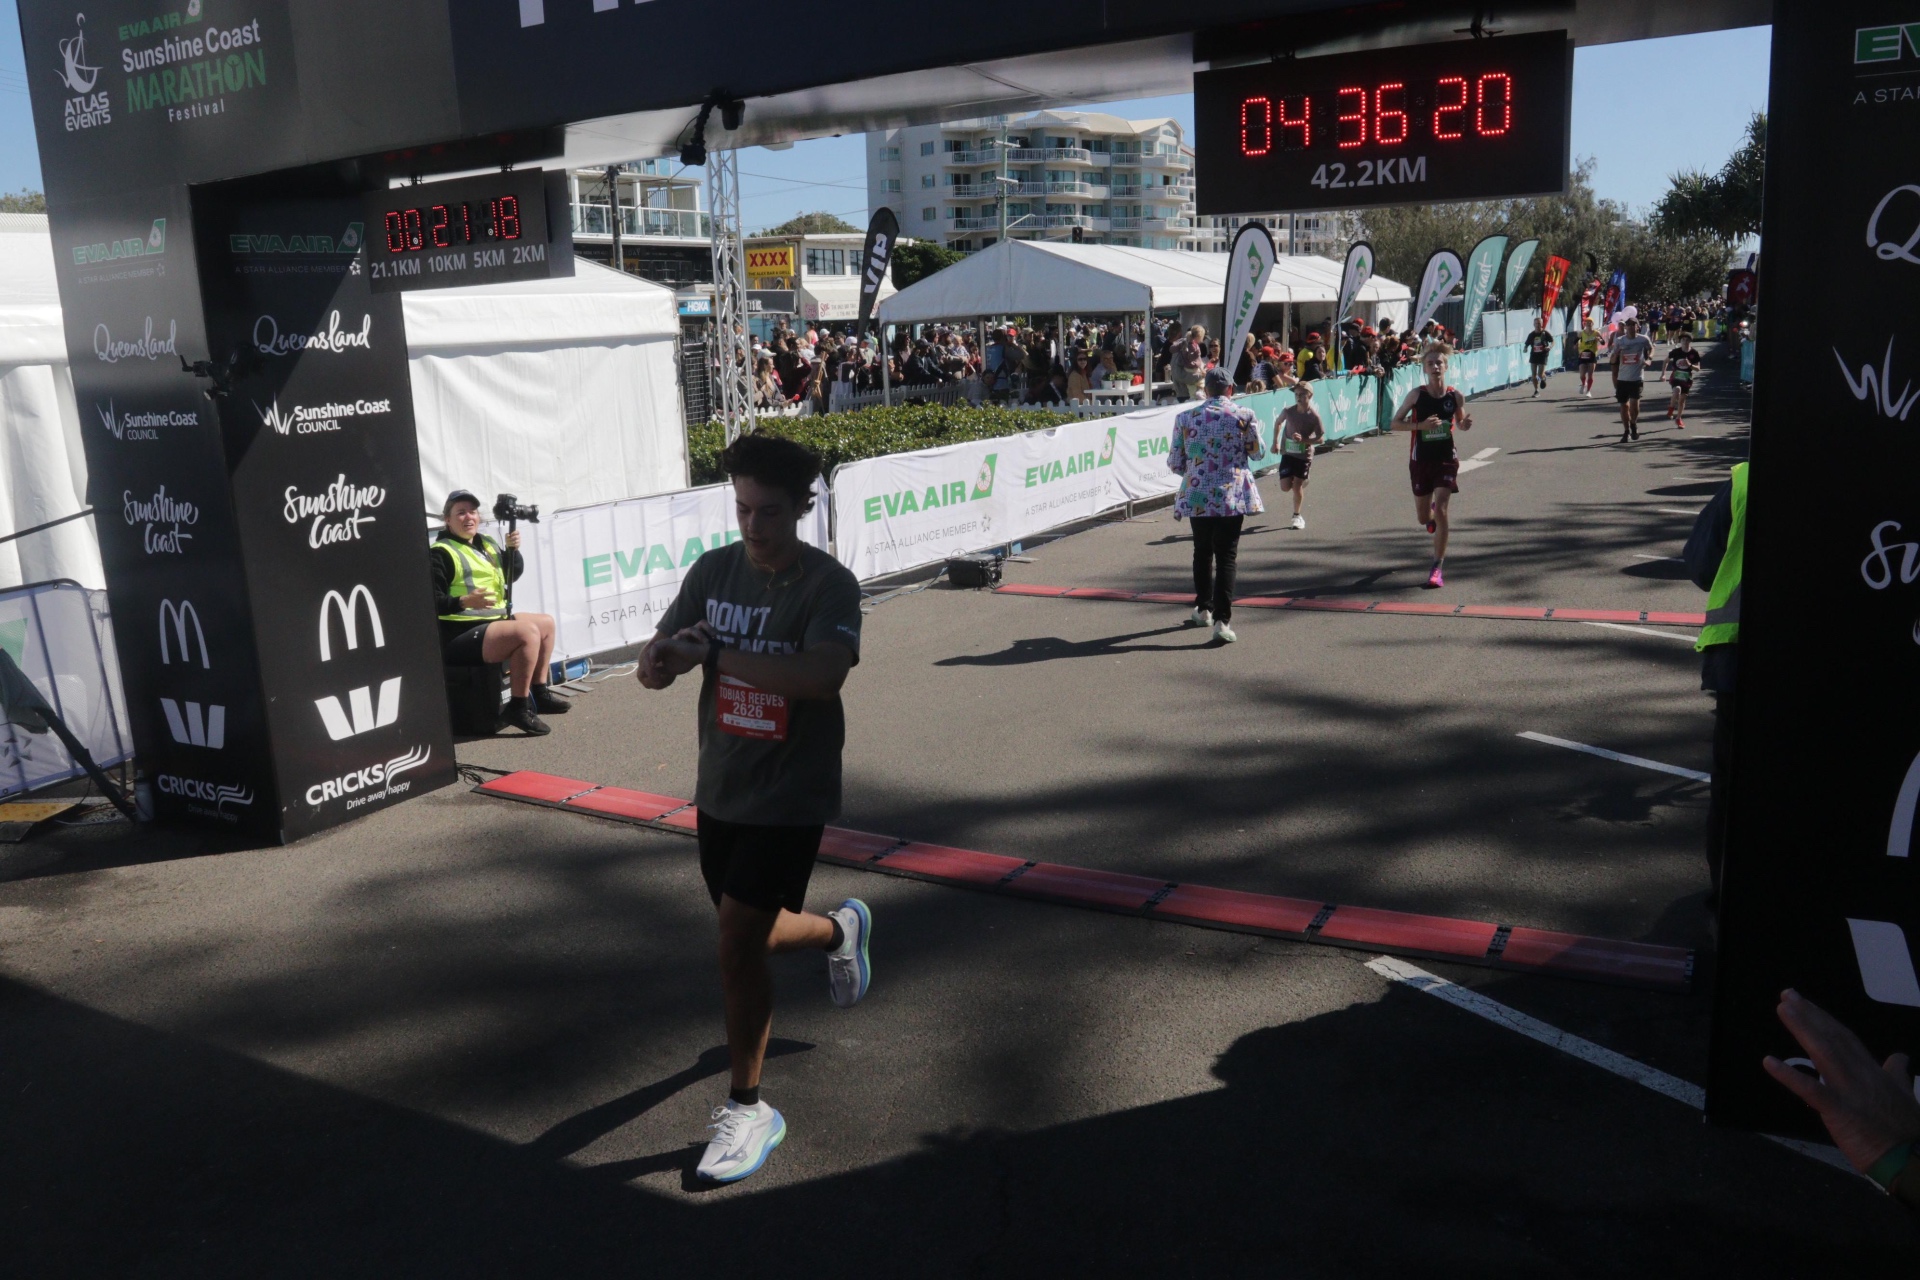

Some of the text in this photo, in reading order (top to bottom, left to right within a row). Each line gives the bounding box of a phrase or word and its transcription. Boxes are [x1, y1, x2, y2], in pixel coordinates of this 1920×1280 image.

[122, 18, 261, 73] Sunshine Coast
[126, 48, 267, 114] MARATHON
[64, 91, 111, 117] ATLAS
[168, 98, 226, 123] Festival
[1853, 91, 1867, 105] A
[65, 108, 112, 132] EVENTS
[1242, 72, 1512, 156] 04 36 20
[1310, 156, 1428, 190] 42.2KM
[243, 265, 266, 274] STAR
[268, 265, 309, 274] ALLIANCE
[310, 264, 347, 273] MEMBER
[371, 244, 546, 279] 21.1KM 10KM 5KM 2KM
[749, 251, 788, 266] XXXX
[863, 232, 888, 294] VIP
[99, 271, 128, 283] ALLIANCE
[128, 268, 155, 279] MEMBER
[687, 301, 709, 312] HOKA
[94, 316, 178, 363] Queensland
[252, 309, 372, 356] Queensland
[124, 410, 198, 428] Sunshine Coast
[294, 398, 391, 421] Sunshine Coast
[127, 429, 159, 440] COUNCIL
[296, 420, 341, 434] COUNCIL
[123, 485, 199, 526] Sunshine
[284, 473, 386, 524] Sunshine
[1031, 502, 1048, 516] STAR
[1048, 492, 1078, 512] ALLIANCE
[1078, 485, 1102, 500] MEMBER
[144, 522, 193, 555] Coast
[309, 508, 376, 549] Coast
[897, 529, 941, 549] ALLIANCE
[942, 520, 978, 537] MEMBER
[588, 615, 597, 628] A
[601, 605, 637, 625] STAR
[706, 598, 772, 636] DON'T
[719, 686, 785, 708] TOBIAS REEVES
[733, 702, 764, 719] 2626
[157, 774, 217, 801] CRICKS
[305, 763, 386, 806] CRICKS
[346, 780, 411, 810] Drive away happy
